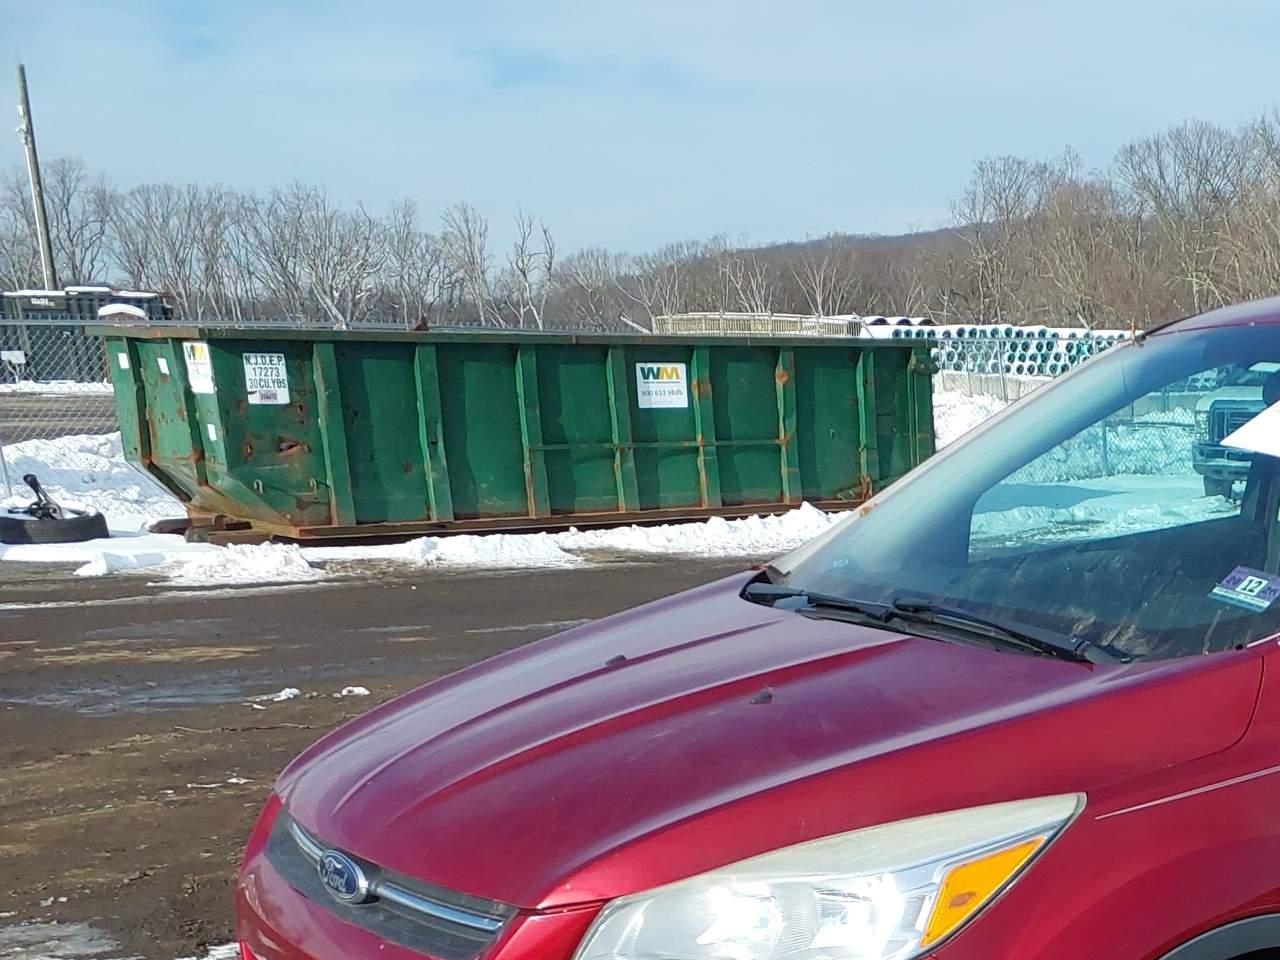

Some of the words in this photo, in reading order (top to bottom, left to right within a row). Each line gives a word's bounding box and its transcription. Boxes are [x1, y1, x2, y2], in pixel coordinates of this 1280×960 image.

[252, 367, 280, 377] 17273
[640, 366, 681, 380] WM
[1240, 579, 1263, 593] 12
[323, 857, 347, 892] Ford
